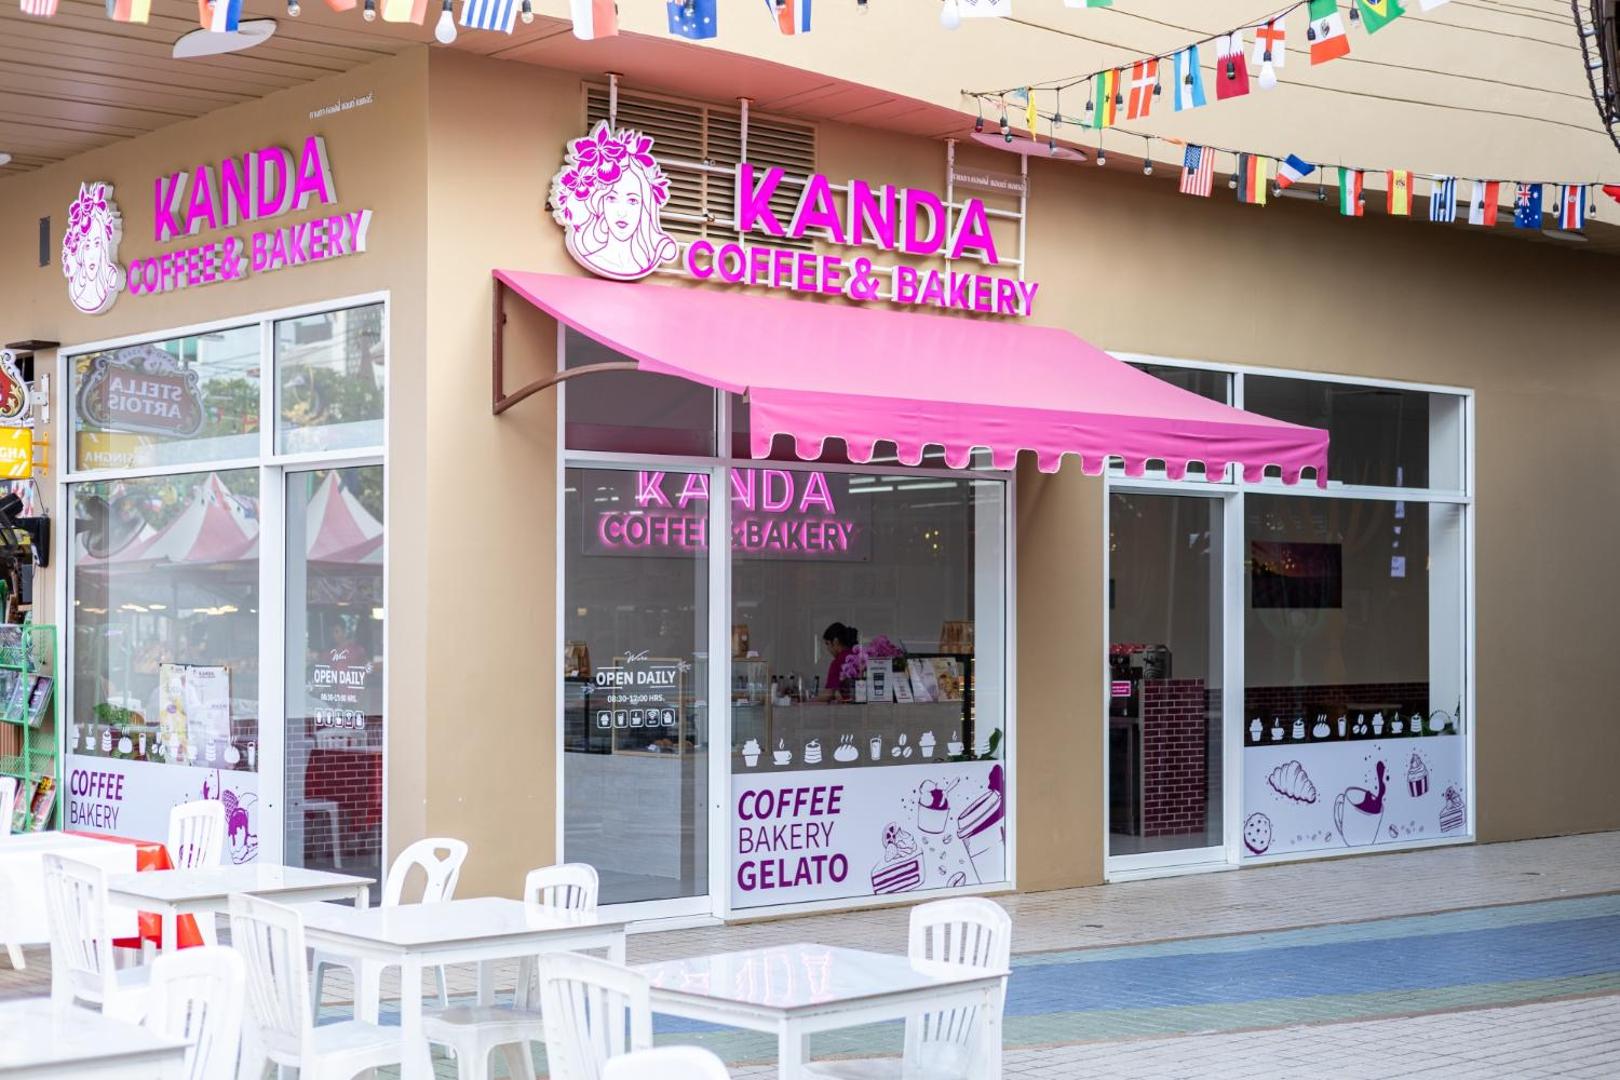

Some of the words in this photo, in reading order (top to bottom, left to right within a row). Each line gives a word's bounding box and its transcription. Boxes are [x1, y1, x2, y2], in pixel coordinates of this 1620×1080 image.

[155, 136, 336, 242] KANDA
[734, 162, 999, 266] KANDA
[128, 244, 221, 295] COFFEE
[220, 236, 248, 280] &
[252, 210, 372, 272] BAKERY
[684, 240, 842, 294] COFFEE
[848, 257, 880, 301] &
[893, 264, 1039, 317] BAKERY
[0, 447, 26, 459] GHA
[638, 468, 836, 514] KANDA
[745, 519, 854, 550] BAKERY
[314, 669, 338, 684] OPEN
[339, 671, 365, 686] DAILY
[596, 671, 633, 685] OPEN
[637, 670, 676, 684] DAILY
[70, 769, 125, 801] COFFEE
[70, 800, 120, 830] BAKERY
[738, 785, 844, 821] COFFEE
[738, 821, 834, 854] BAKERY
[737, 853, 848, 891] GELATO
